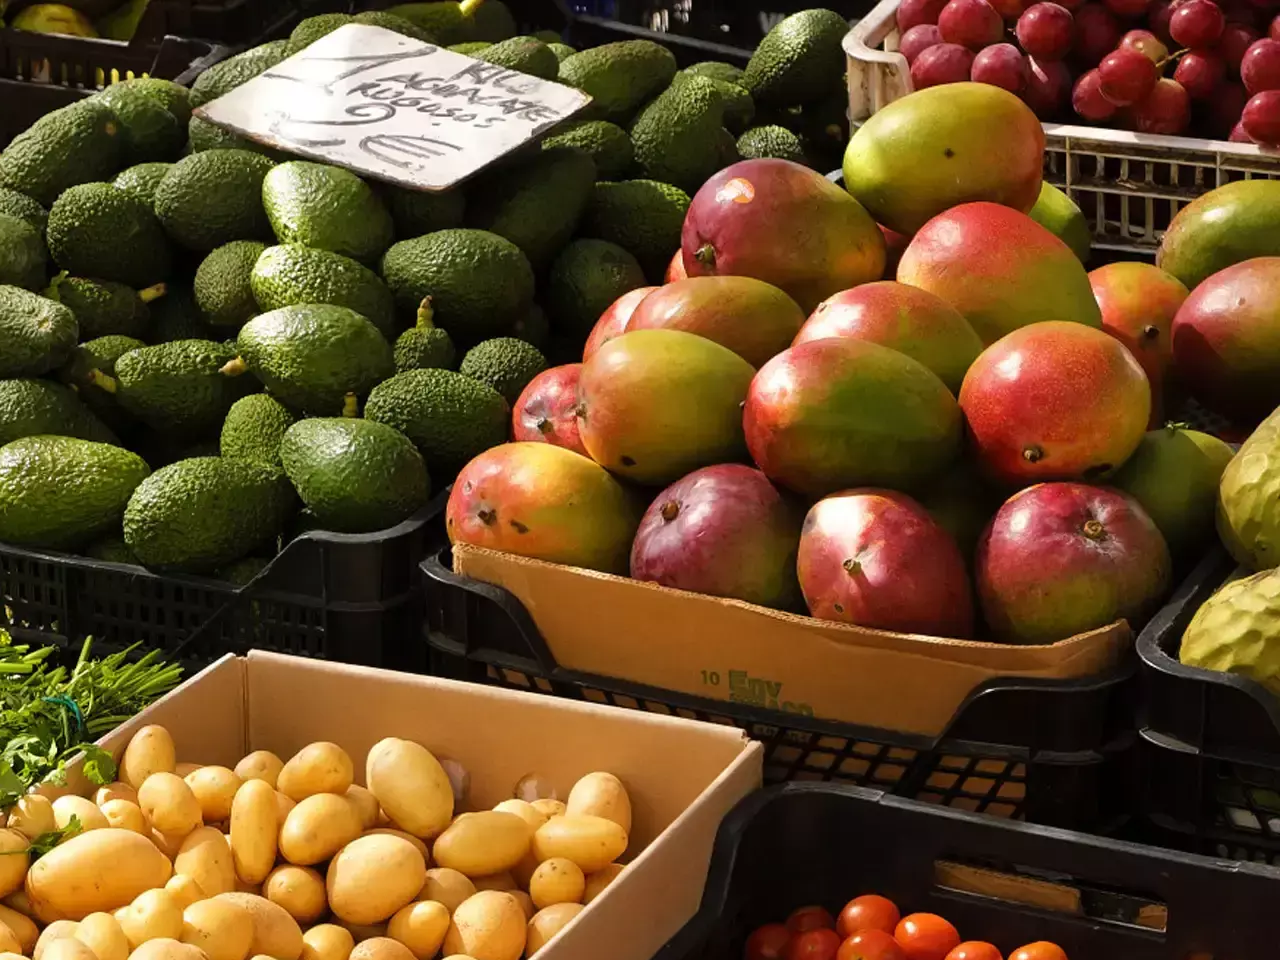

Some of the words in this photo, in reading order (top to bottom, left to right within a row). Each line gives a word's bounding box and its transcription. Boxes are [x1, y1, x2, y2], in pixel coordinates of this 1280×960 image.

[443, 63, 542, 95] KILO
[346, 81, 506, 128] RUGOSOS
[699, 669, 720, 685] 10
